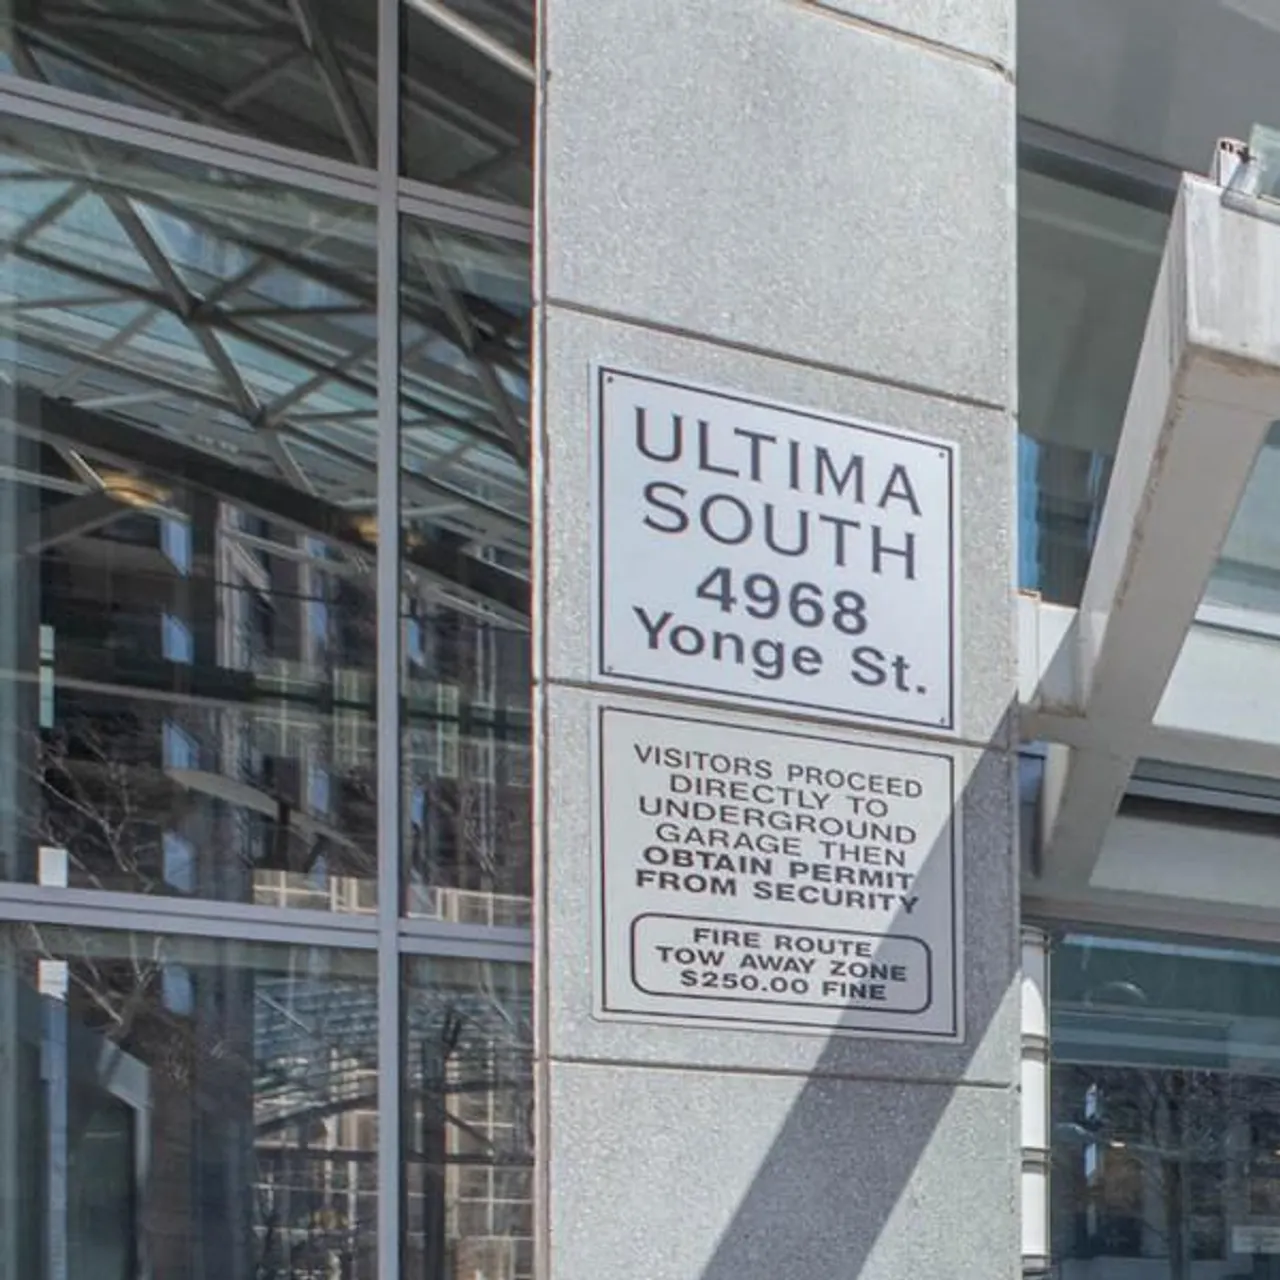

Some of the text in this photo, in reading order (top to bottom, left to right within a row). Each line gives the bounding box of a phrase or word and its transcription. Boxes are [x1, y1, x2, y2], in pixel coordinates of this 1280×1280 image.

[635, 406, 922, 516] ULTIMA
[643, 481, 916, 580] SOUTH
[696, 567, 867, 635] 4968
[632, 605, 926, 694] Yonge St.
[634, 744, 922, 798] VISITORS PROCEED
[670, 774, 889, 817] DIRECTLY TO
[639, 796, 917, 845] UNDERGROUND
[655, 823, 906, 867] GARAGE THEN
[635, 869, 919, 914] FROM SECURITY
[643, 847, 913, 891] OBTAIN PERMIT
[655, 946, 906, 982] TOW AWAY ZONE
[693, 928, 871, 957] FIRE ROUTE
[680, 970, 886, 1000] $250.00 FINE
